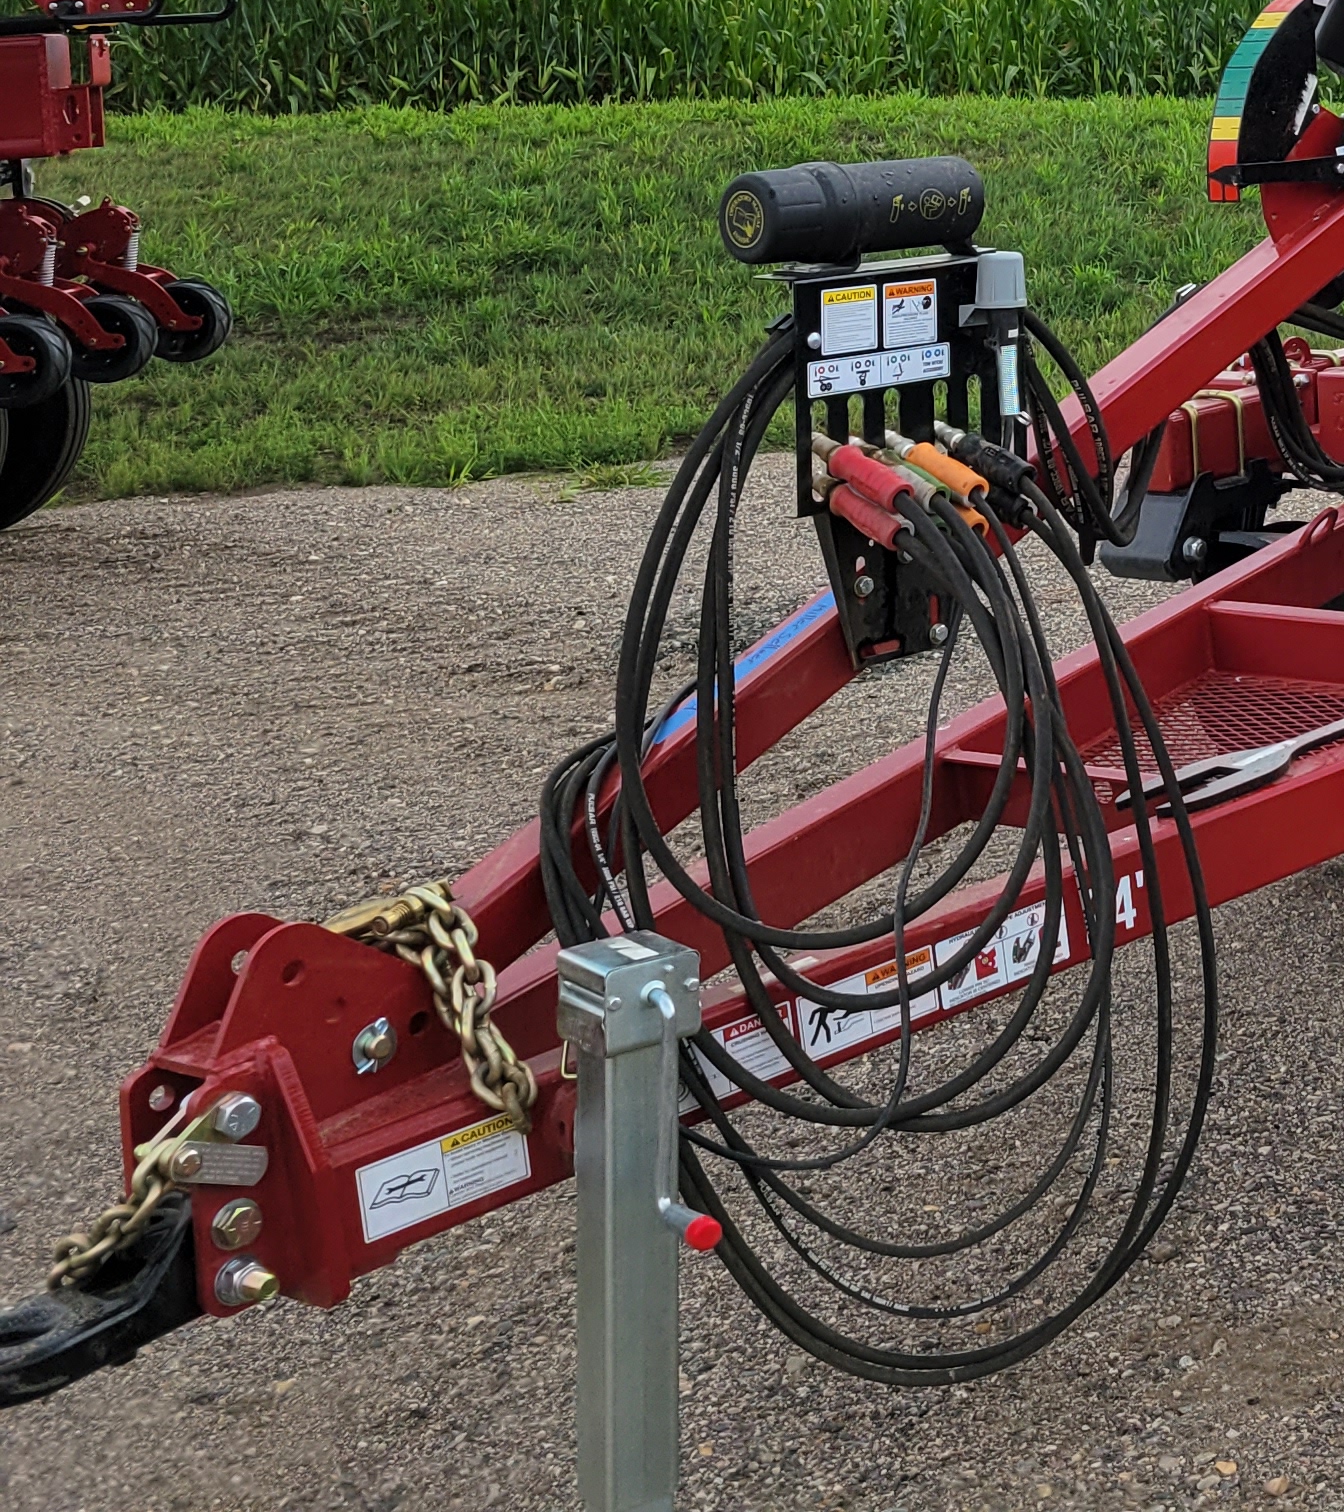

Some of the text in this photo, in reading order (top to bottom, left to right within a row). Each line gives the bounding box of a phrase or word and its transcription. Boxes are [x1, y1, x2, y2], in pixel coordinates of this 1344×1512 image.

[835, 290, 872, 302] CAUTION
[896, 284, 933, 295] WARNING
[1014, 901, 1046, 918] ADJUSTMEN
[881, 953, 926, 978] WANING
[460, 1117, 513, 1144] CAUTION
